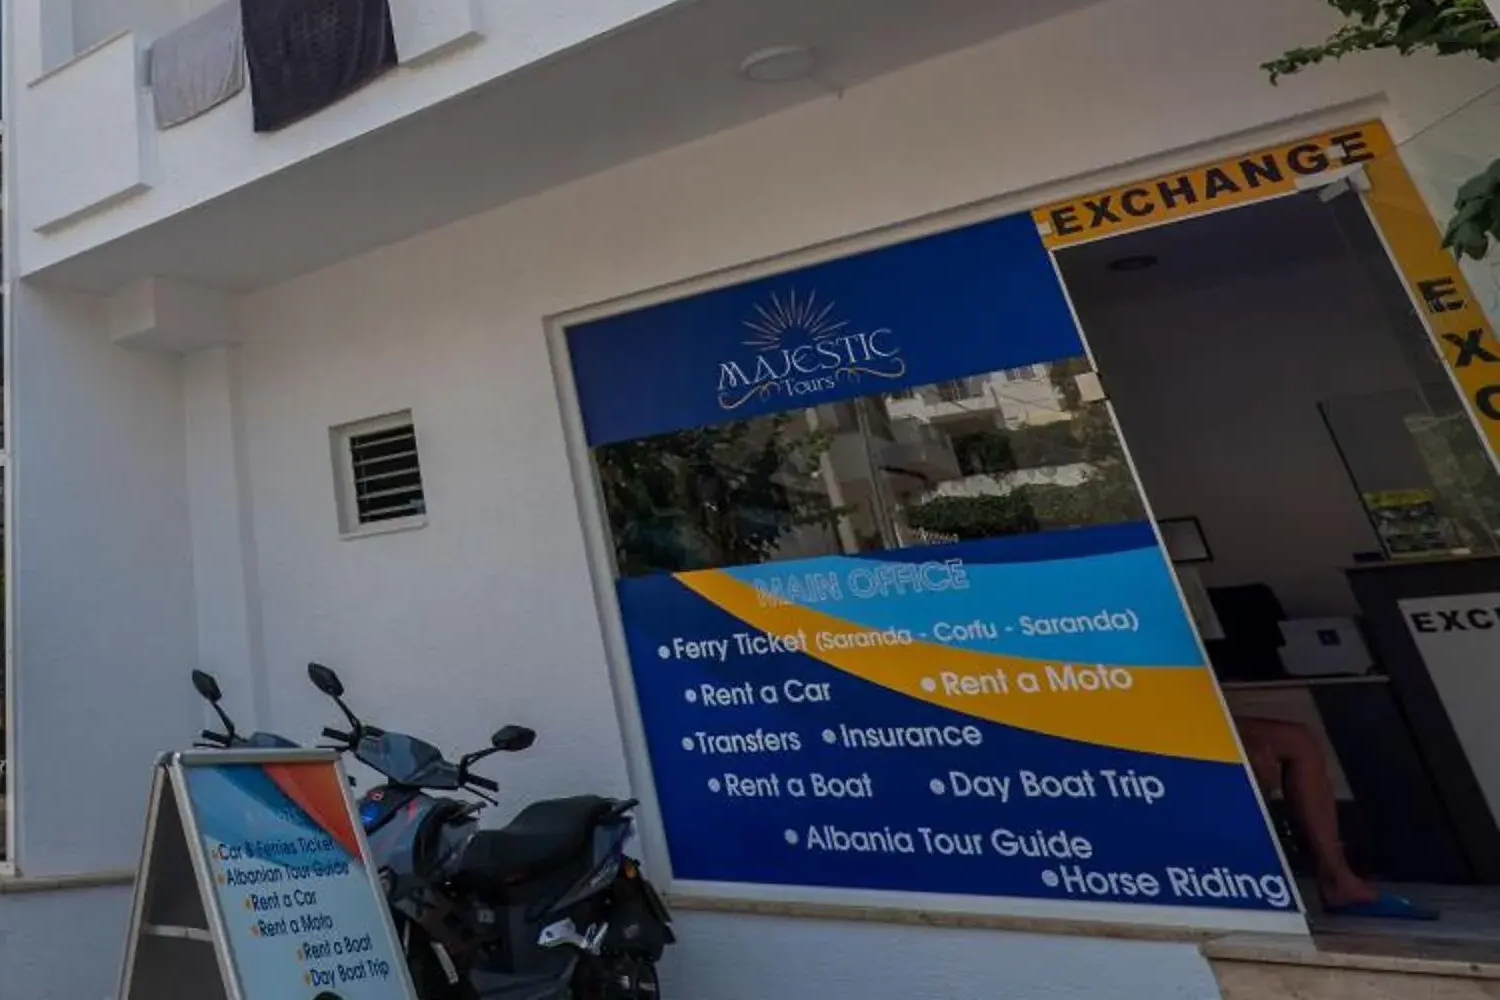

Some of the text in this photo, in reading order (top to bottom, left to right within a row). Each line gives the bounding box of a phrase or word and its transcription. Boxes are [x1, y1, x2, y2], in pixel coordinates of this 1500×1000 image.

[1050, 131, 1374, 236] EXCHANGE
[717, 328, 899, 390] MAJESTIC
[780, 374, 835, 396] Tours
[753, 558, 970, 607] MAIN OFFICE
[1410, 607, 1500, 634] EXC
[672, 637, 729, 661] Ferry
[733, 628, 808, 655] Ticket
[815, 626, 913, 652] (Saranda
[933, 620, 998, 641] Corfu
[1018, 608, 1139, 636] Saranda)
[700, 679, 832, 706] Rent a Car
[940, 664, 1134, 696] Rent a Moto
[695, 728, 802, 754] Transfers
[839, 723, 983, 748] Insurance
[723, 772, 873, 797] Rent a Boat
[949, 769, 1165, 804] Day Boat Trip
[218, 843, 242, 861] Car
[807, 825, 1093, 859] Albania Tour Guide
[227, 865, 283, 887] Albanian
[285, 863, 311, 880] Tour
[1060, 865, 1291, 907] Horse Riding
[251, 889, 317, 911] Rent a Car
[258, 913, 333, 938] Rent a Moto
[303, 933, 373, 960] Rent a Boat
[310, 958, 390, 988] Day Boat Trip
